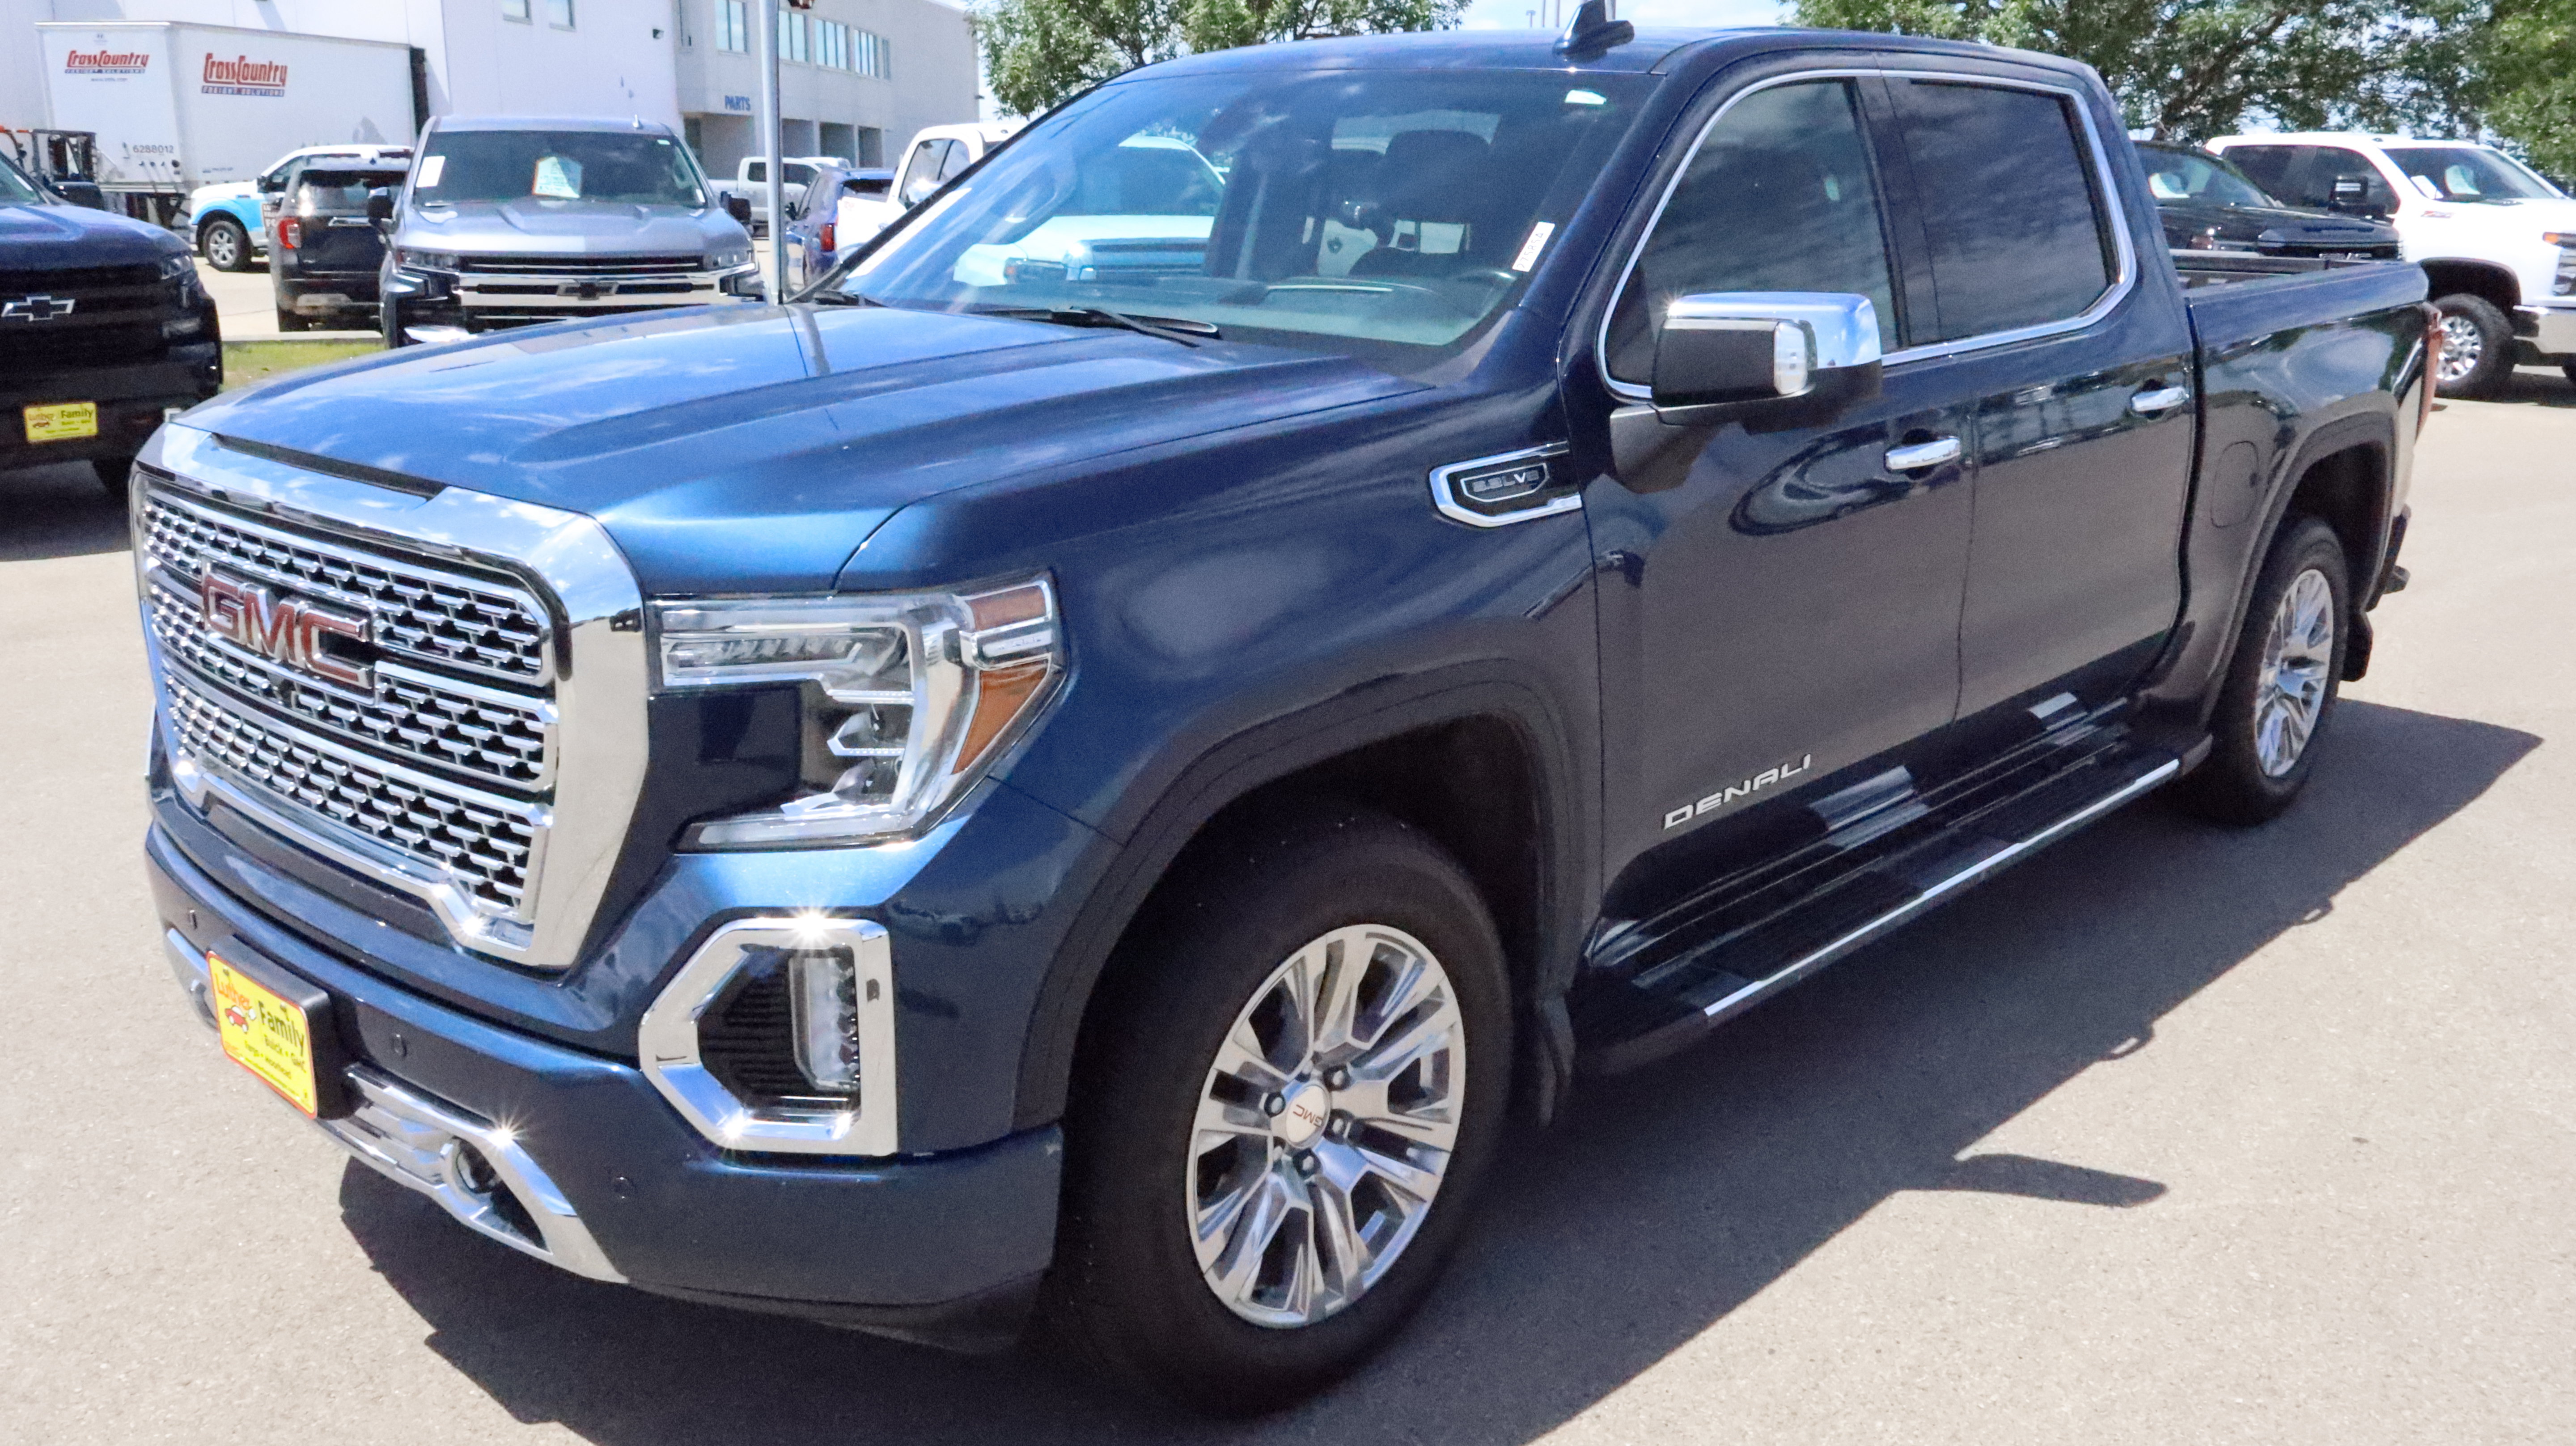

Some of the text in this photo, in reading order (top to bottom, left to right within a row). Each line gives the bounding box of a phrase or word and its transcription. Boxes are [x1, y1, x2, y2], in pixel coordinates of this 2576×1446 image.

[67, 50, 149, 67] CrossCountry
[203, 52, 288, 86] CrossCountry
[725, 95, 750, 111] PARTS
[133, 144, 174, 153] 6288012
[61, 408, 93, 418] Family
[203, 572, 373, 689] GMC
[1665, 754, 1811, 830] DENALI
[258, 1000, 305, 1057] Family
[1293, 1104, 1323, 1128] GMC
